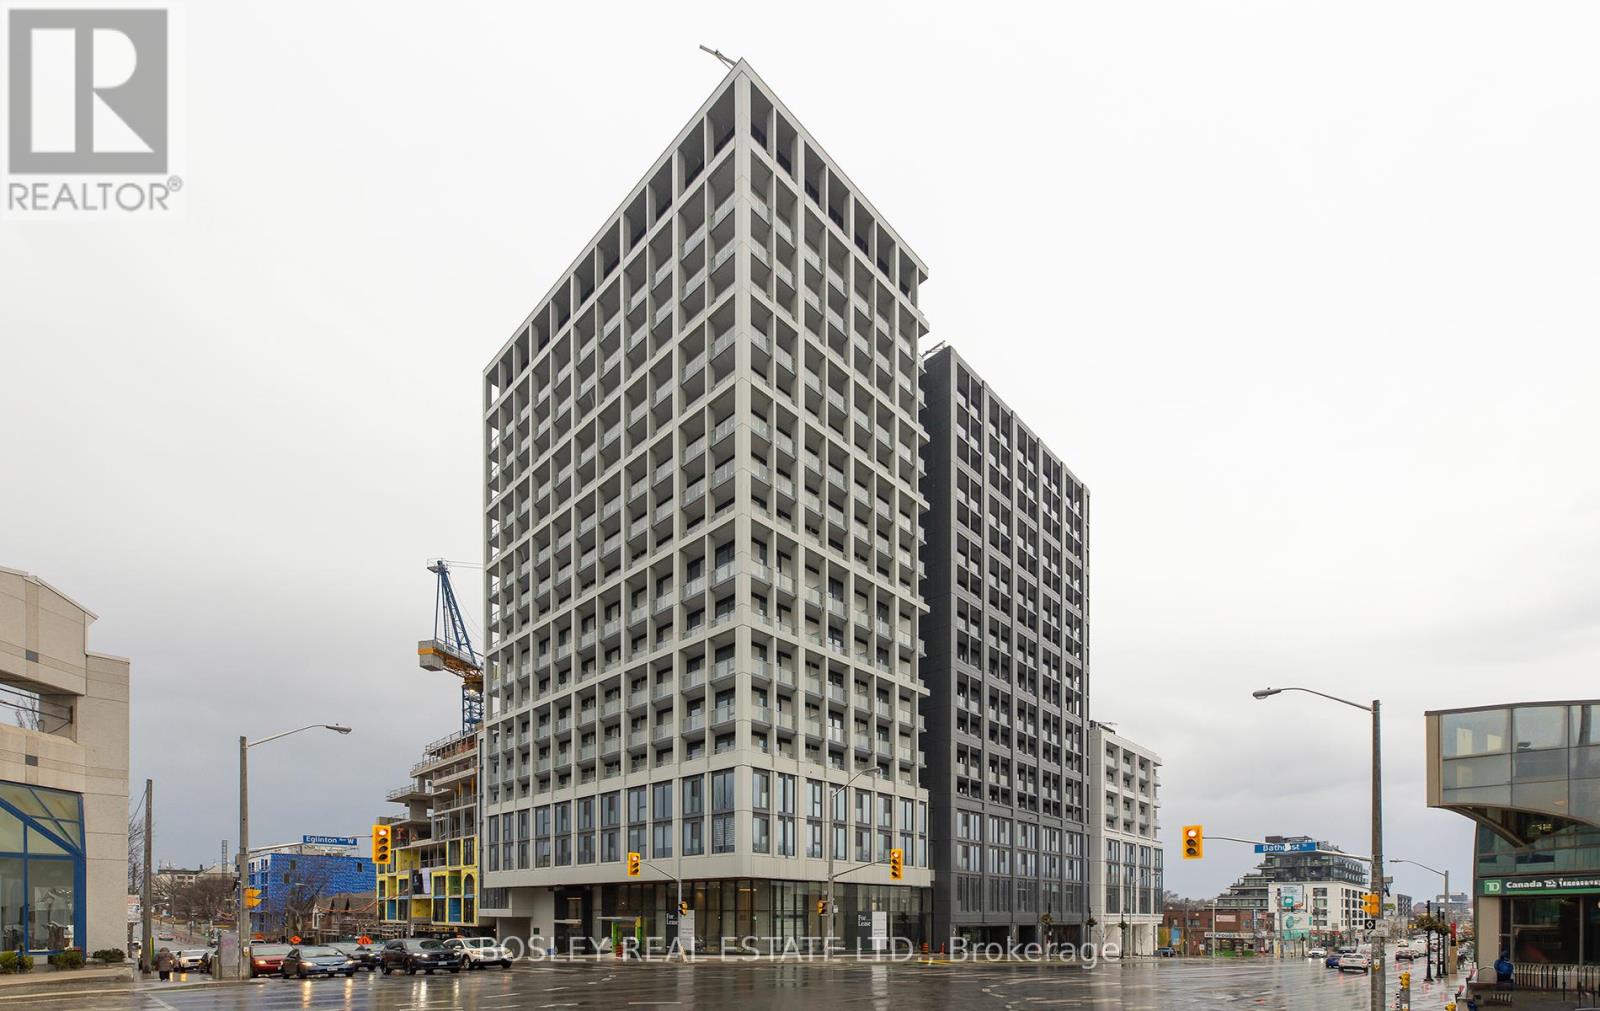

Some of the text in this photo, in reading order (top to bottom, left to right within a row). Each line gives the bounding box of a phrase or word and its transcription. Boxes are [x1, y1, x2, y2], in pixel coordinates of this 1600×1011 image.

[305, 836, 338, 844] Eglinton
[1263, 843, 1300, 851] Bathst
[1486, 882, 1500, 892] TD
[1506, 880, 1542, 889] Canada
